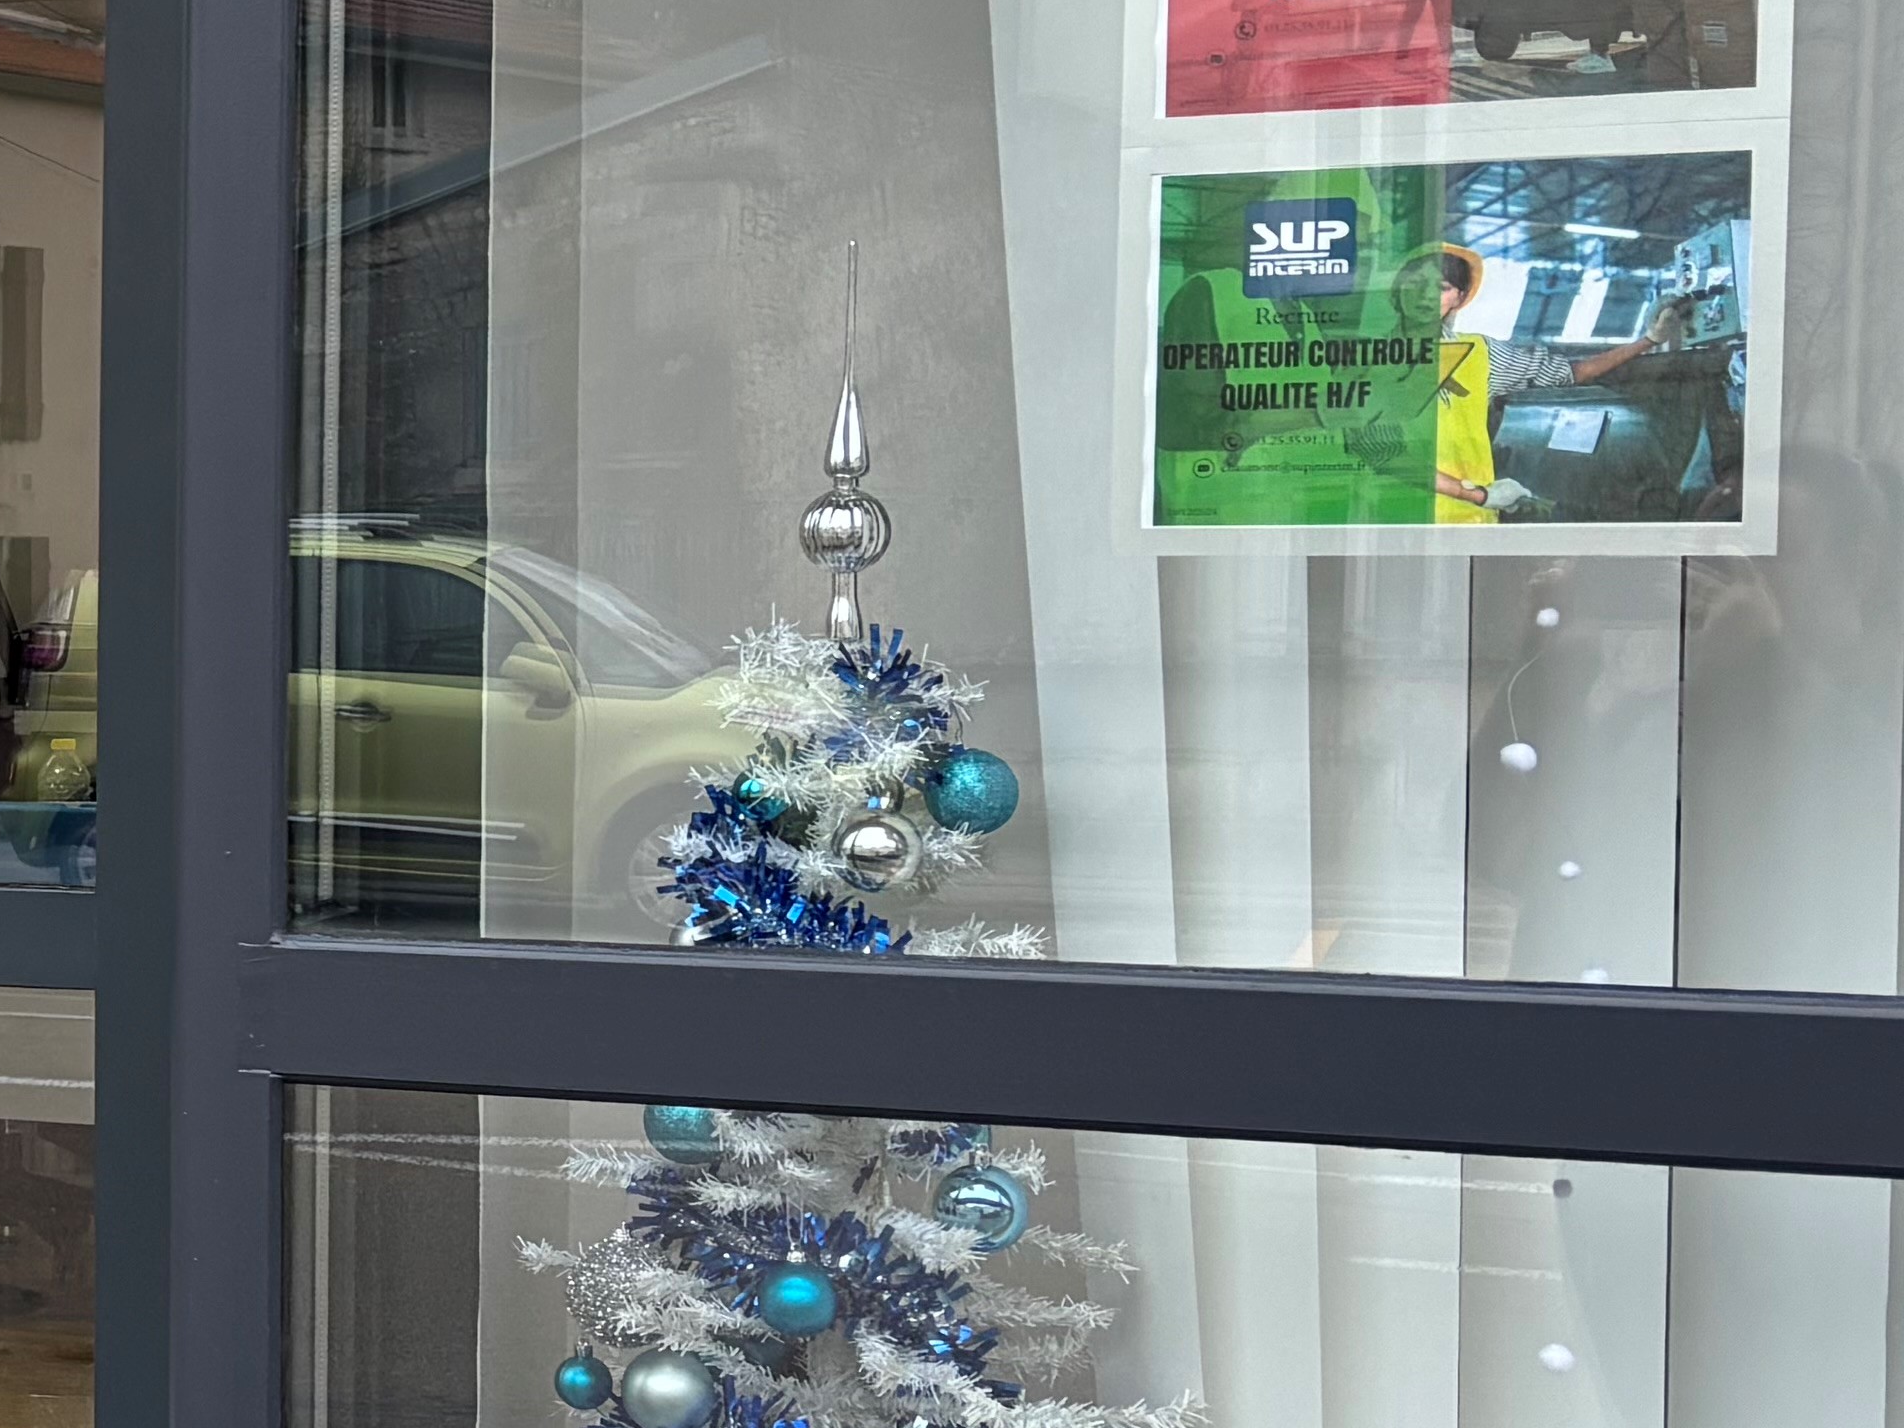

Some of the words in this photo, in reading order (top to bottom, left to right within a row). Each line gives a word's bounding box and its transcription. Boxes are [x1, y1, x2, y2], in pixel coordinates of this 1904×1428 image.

[1249, 220, 1351, 253] SUP
[1255, 306, 1340, 326] Recrute
[1163, 341, 1301, 370] OPERATEUR
[1308, 337, 1433, 369] CONTROLE
[1220, 382, 1318, 412] QUALITE
[1326, 381, 1372, 409] H/F
